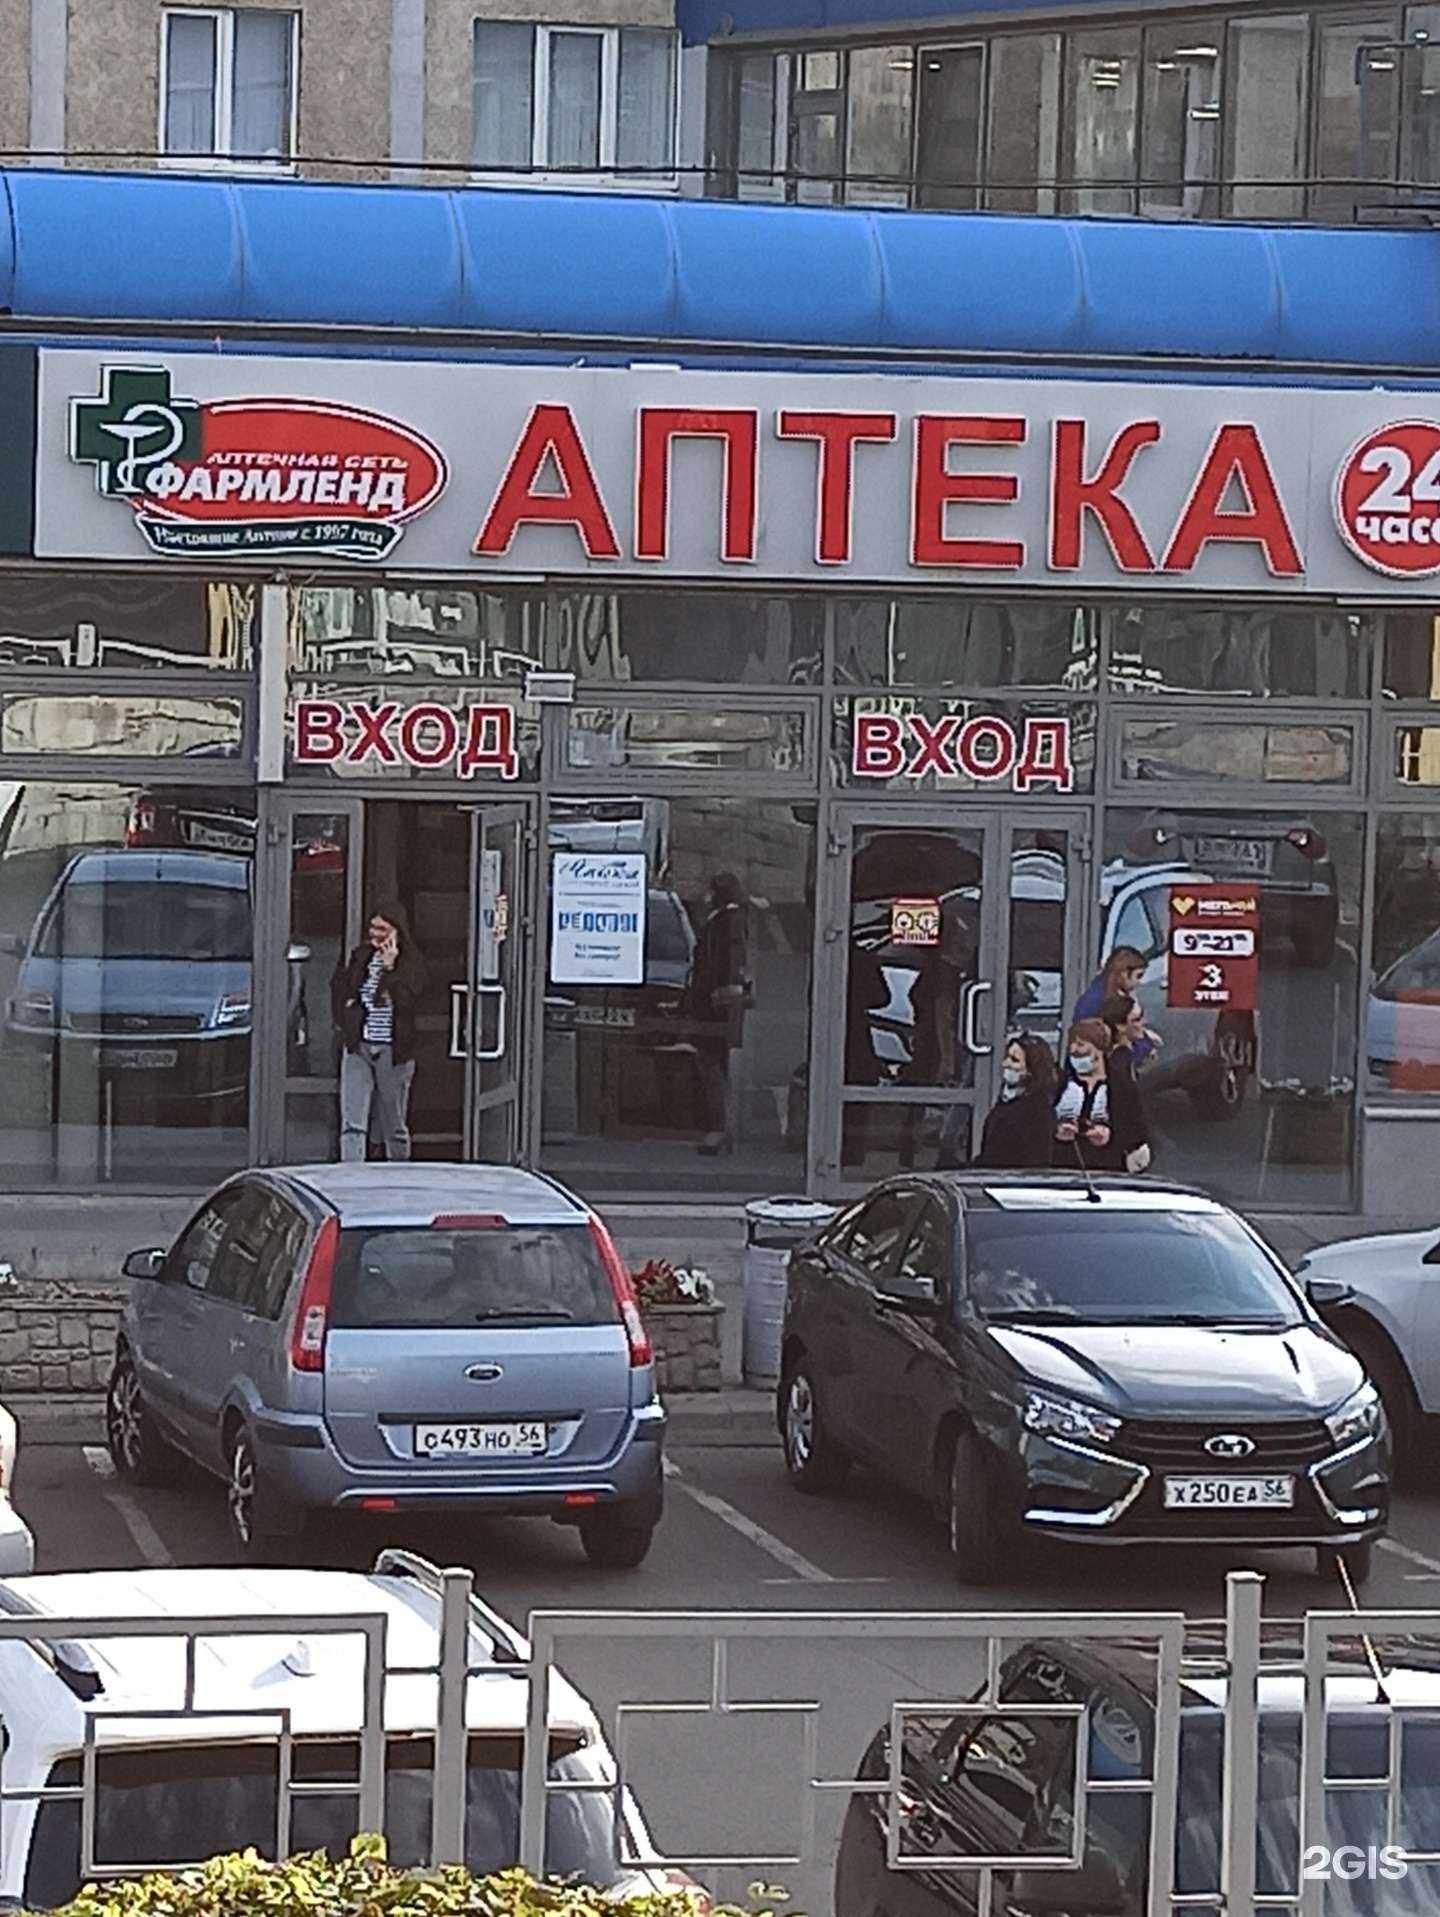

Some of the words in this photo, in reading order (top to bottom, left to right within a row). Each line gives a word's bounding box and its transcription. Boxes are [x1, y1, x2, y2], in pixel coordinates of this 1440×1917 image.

[145, 465, 406, 511] ФАРМЛЕНД
[207, 453, 338, 467] АПТЕЧНАЯ
[345, 456, 408, 468] СЕТЬ
[472, 404, 1305, 577] АПТЕКА
[294, 700, 519, 780] ВХОД
[852, 716, 1073, 792] ВХОД
[1199, 964, 1222, 988] 3
